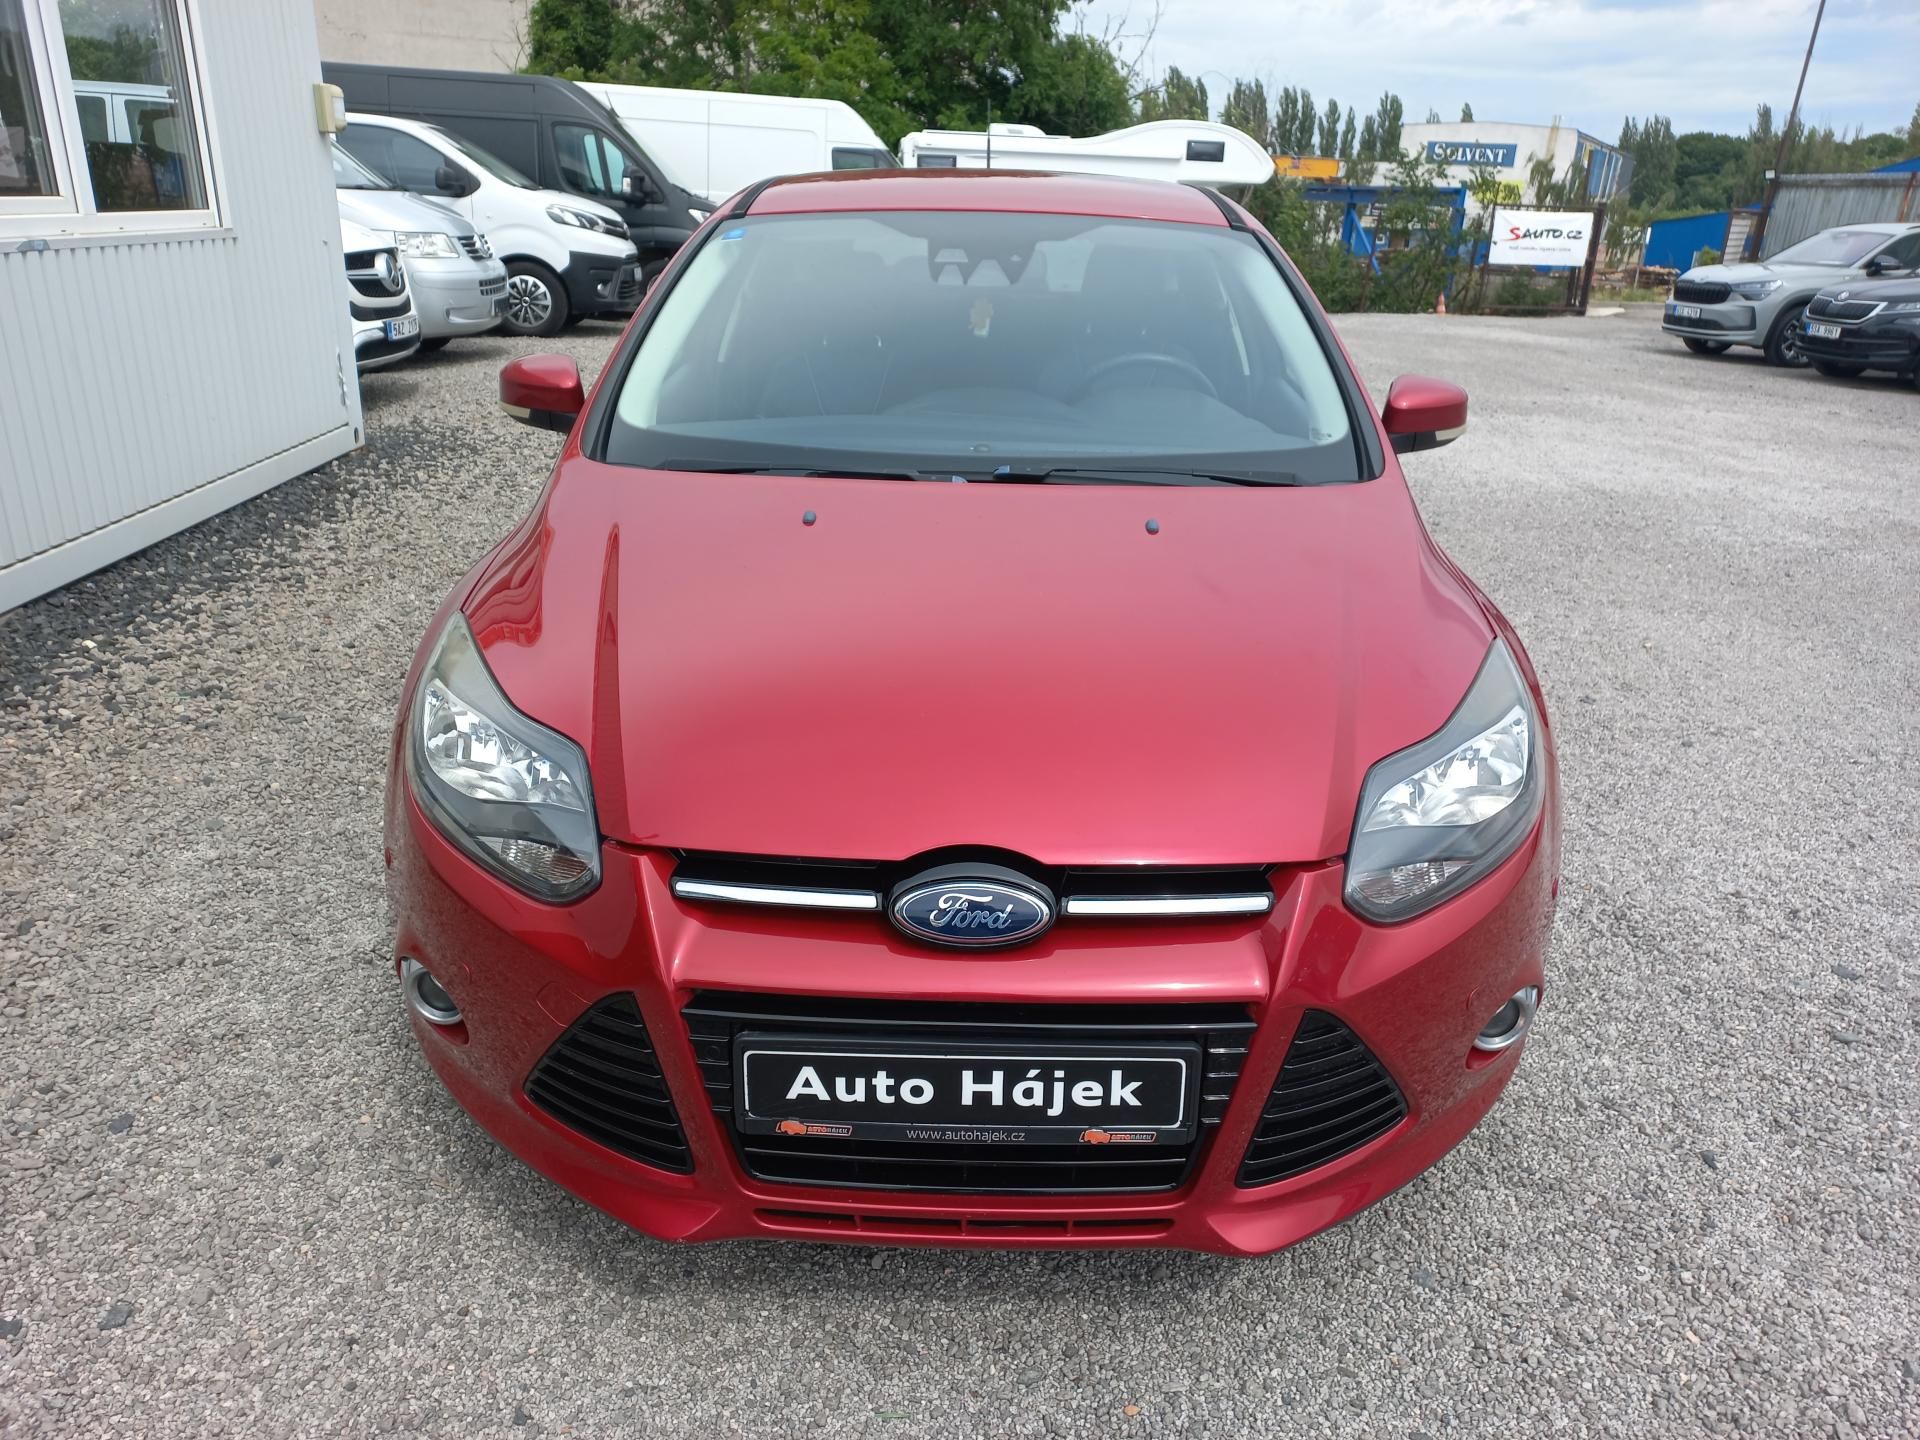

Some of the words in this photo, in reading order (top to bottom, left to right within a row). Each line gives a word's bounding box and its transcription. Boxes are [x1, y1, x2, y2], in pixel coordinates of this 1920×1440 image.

[1433, 143, 1507, 162] SOLVENT
[929, 893, 1014, 928] Ford
[786, 1066, 934, 1105] Auto
[961, 1070, 1142, 1116] Hájek
[906, 1130, 1025, 1143] www.autohajek.cz
